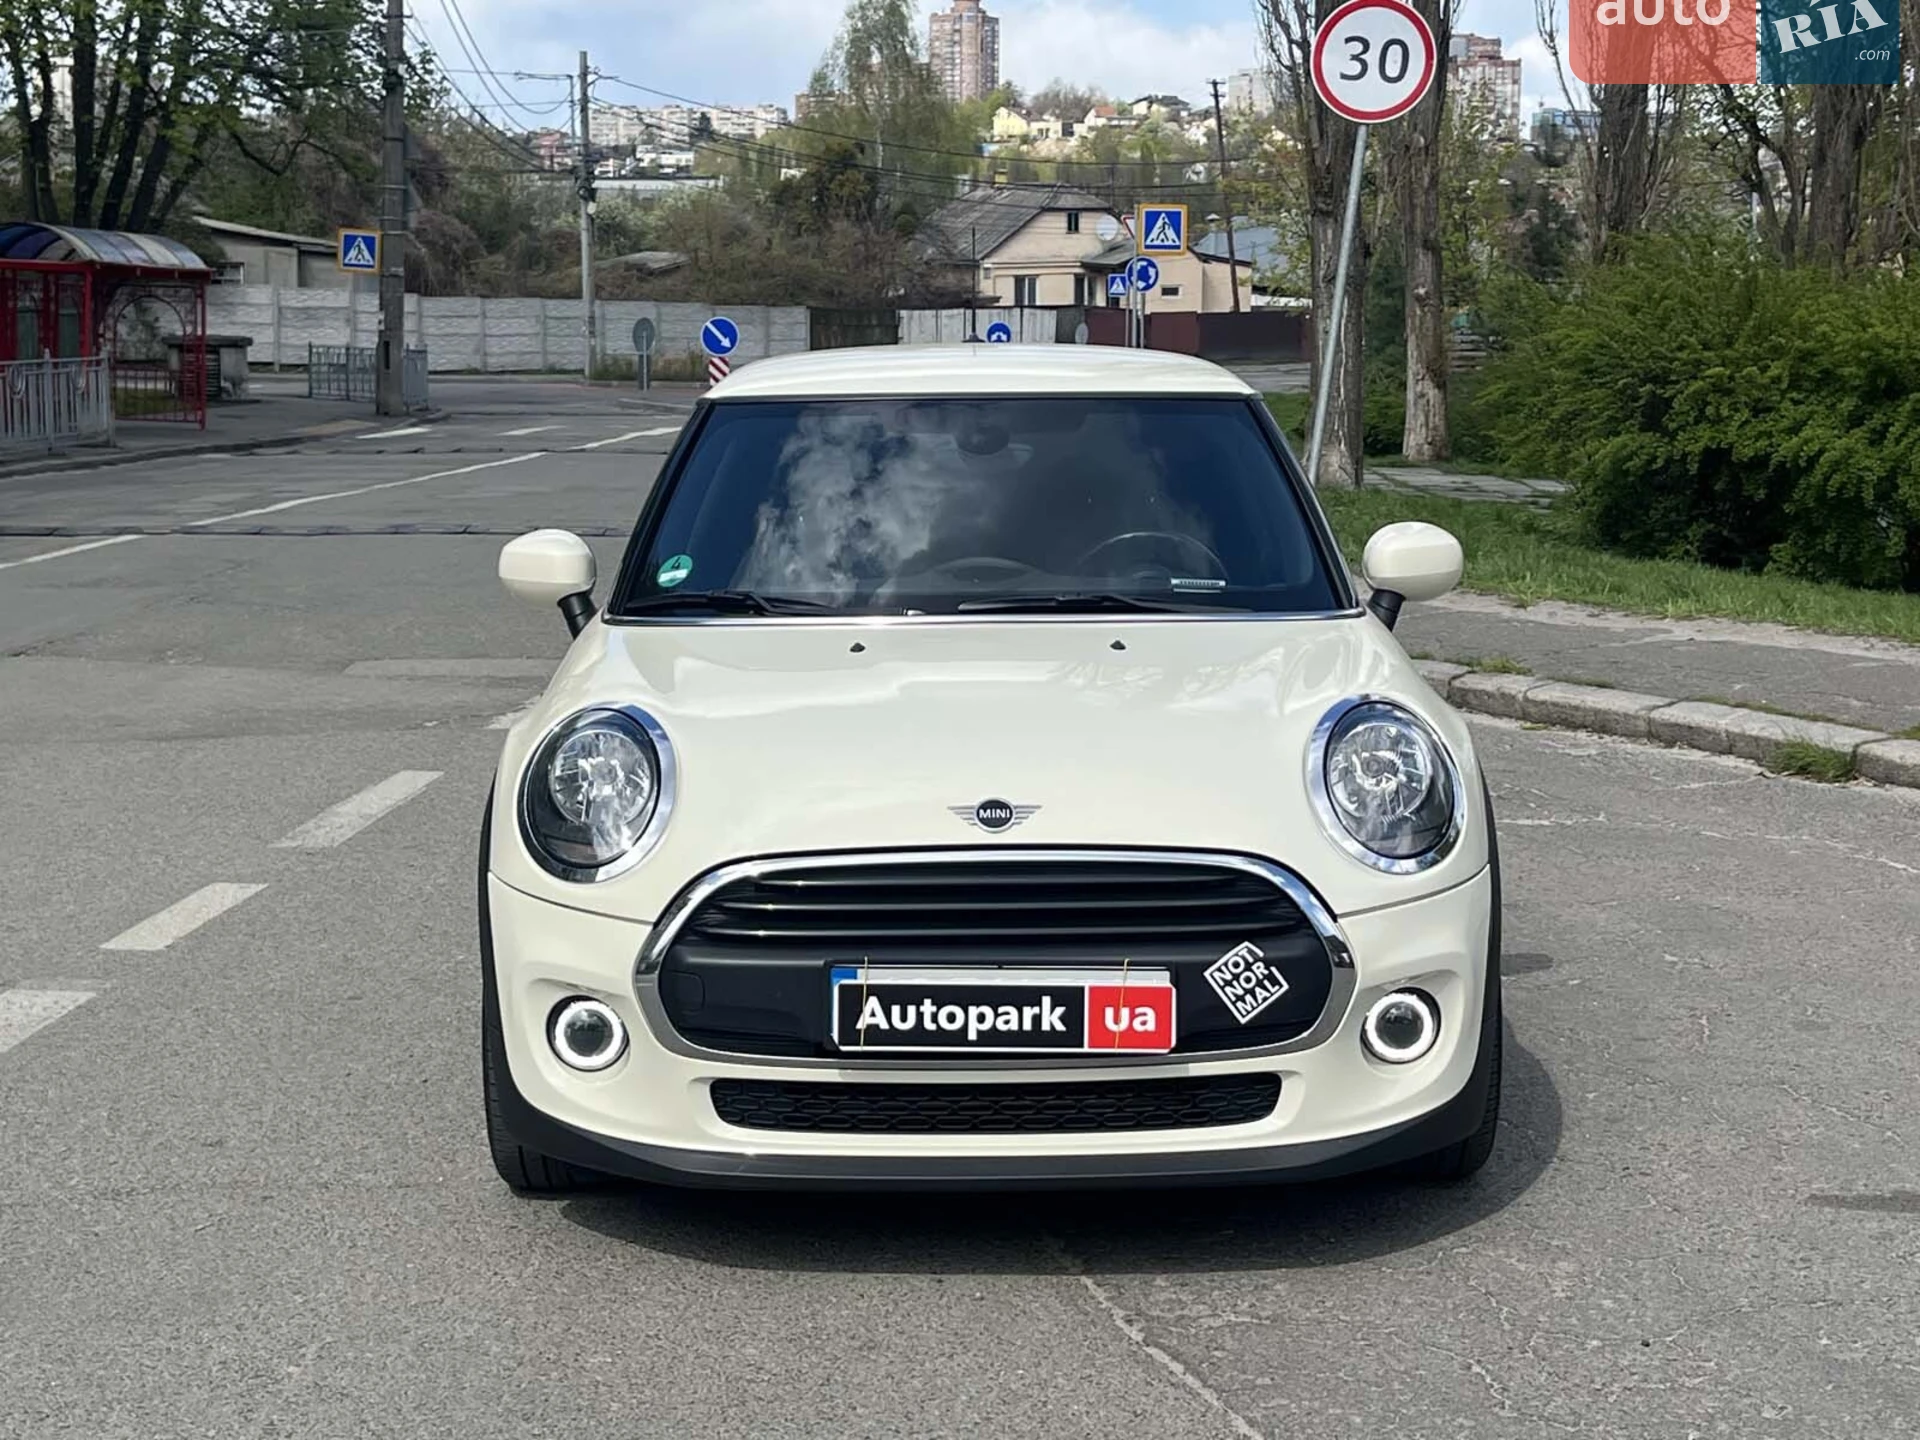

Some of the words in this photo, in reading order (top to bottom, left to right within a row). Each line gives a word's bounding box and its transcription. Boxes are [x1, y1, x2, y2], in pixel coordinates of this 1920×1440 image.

[1339, 35, 1410, 84] 30
[979, 808, 1010, 818] MINI
[1212, 947, 1254, 986] NOT
[1224, 961, 1268, 1001] NOR
[1235, 979, 1280, 1016] MAL
[855, 995, 1067, 1041] Autopark
[1103, 1005, 1156, 1032] ua
